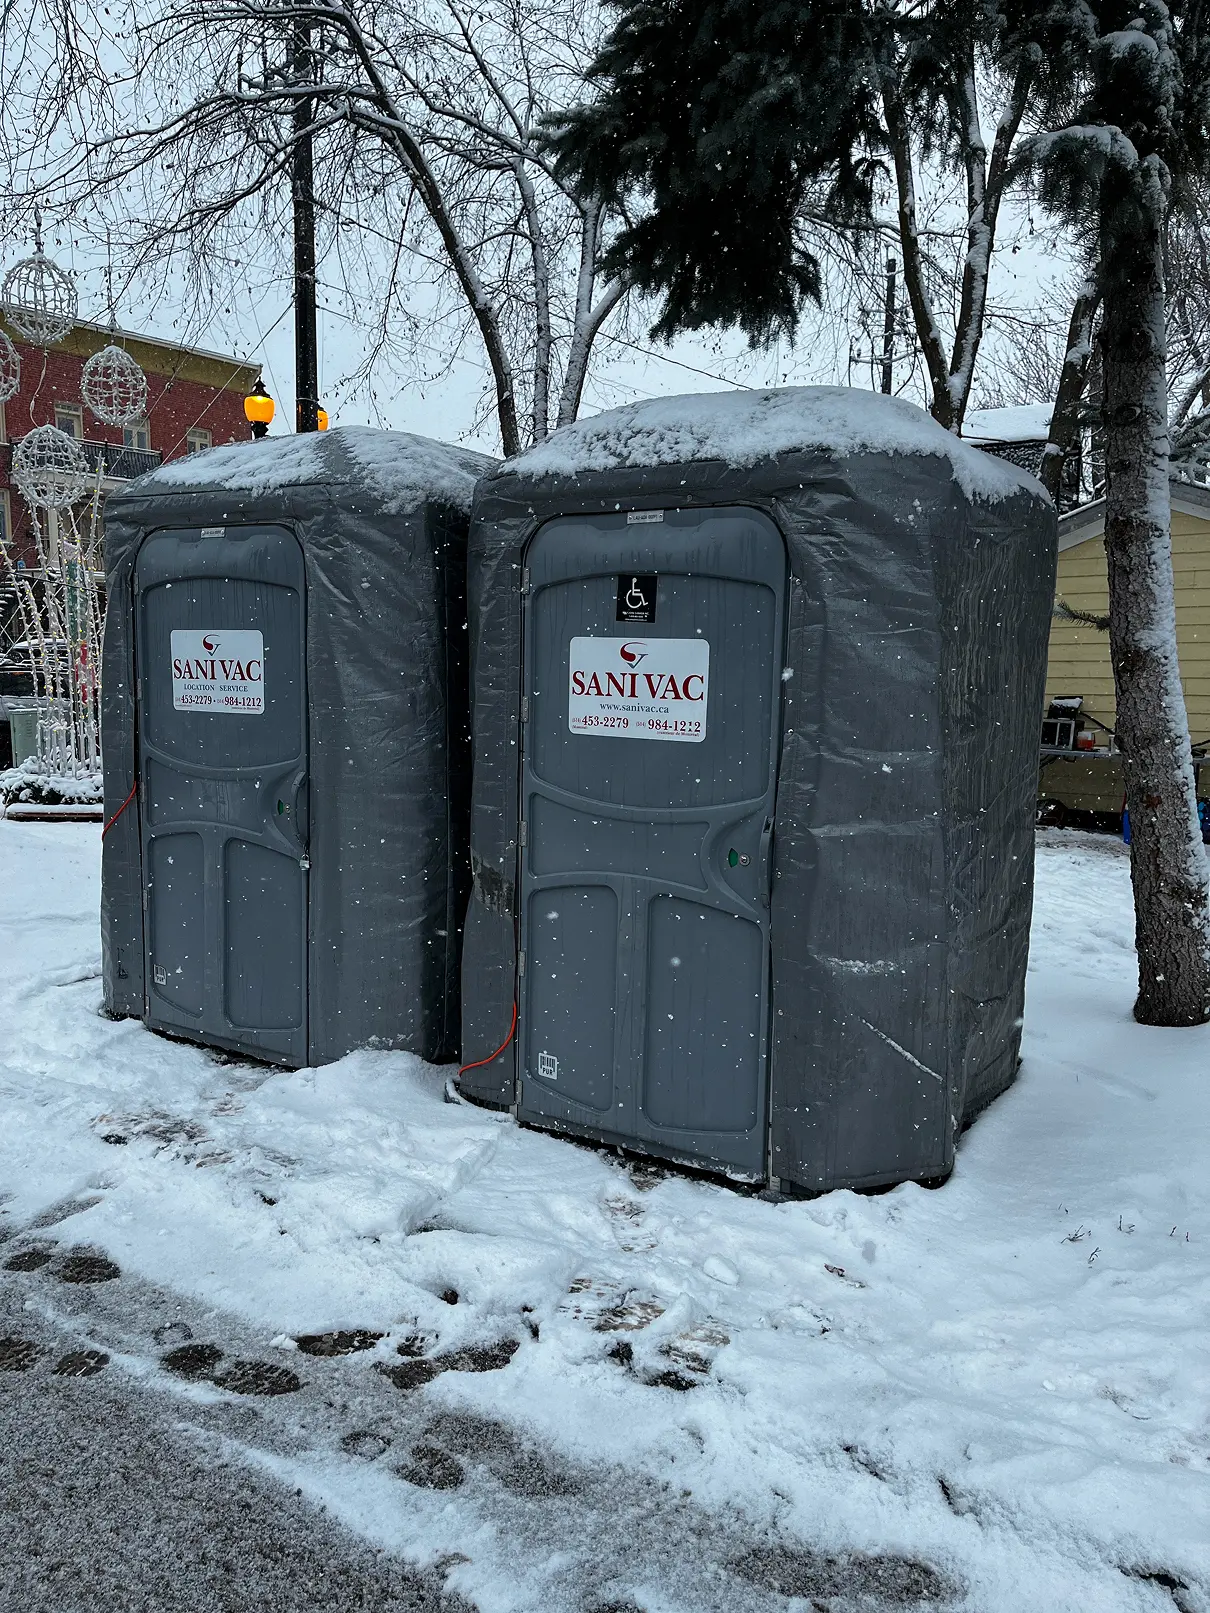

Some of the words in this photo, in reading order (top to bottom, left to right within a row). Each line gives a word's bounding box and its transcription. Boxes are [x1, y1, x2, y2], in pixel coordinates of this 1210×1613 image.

[174, 658, 217, 680] SANI
[218, 659, 262, 682] VAC
[219, 684, 249, 692] SERVICE
[571, 670, 639, 698] SANI
[642, 673, 704, 701] VAC
[181, 694, 212, 705] 453-2279
[224, 696, 262, 707] 984-1212
[599, 702, 670, 714] www.sanivac.ca
[582, 716, 629, 728] 453-2279
[647, 718, 701, 733] 984-1212
[542, 1068, 553, 1076] PUR
